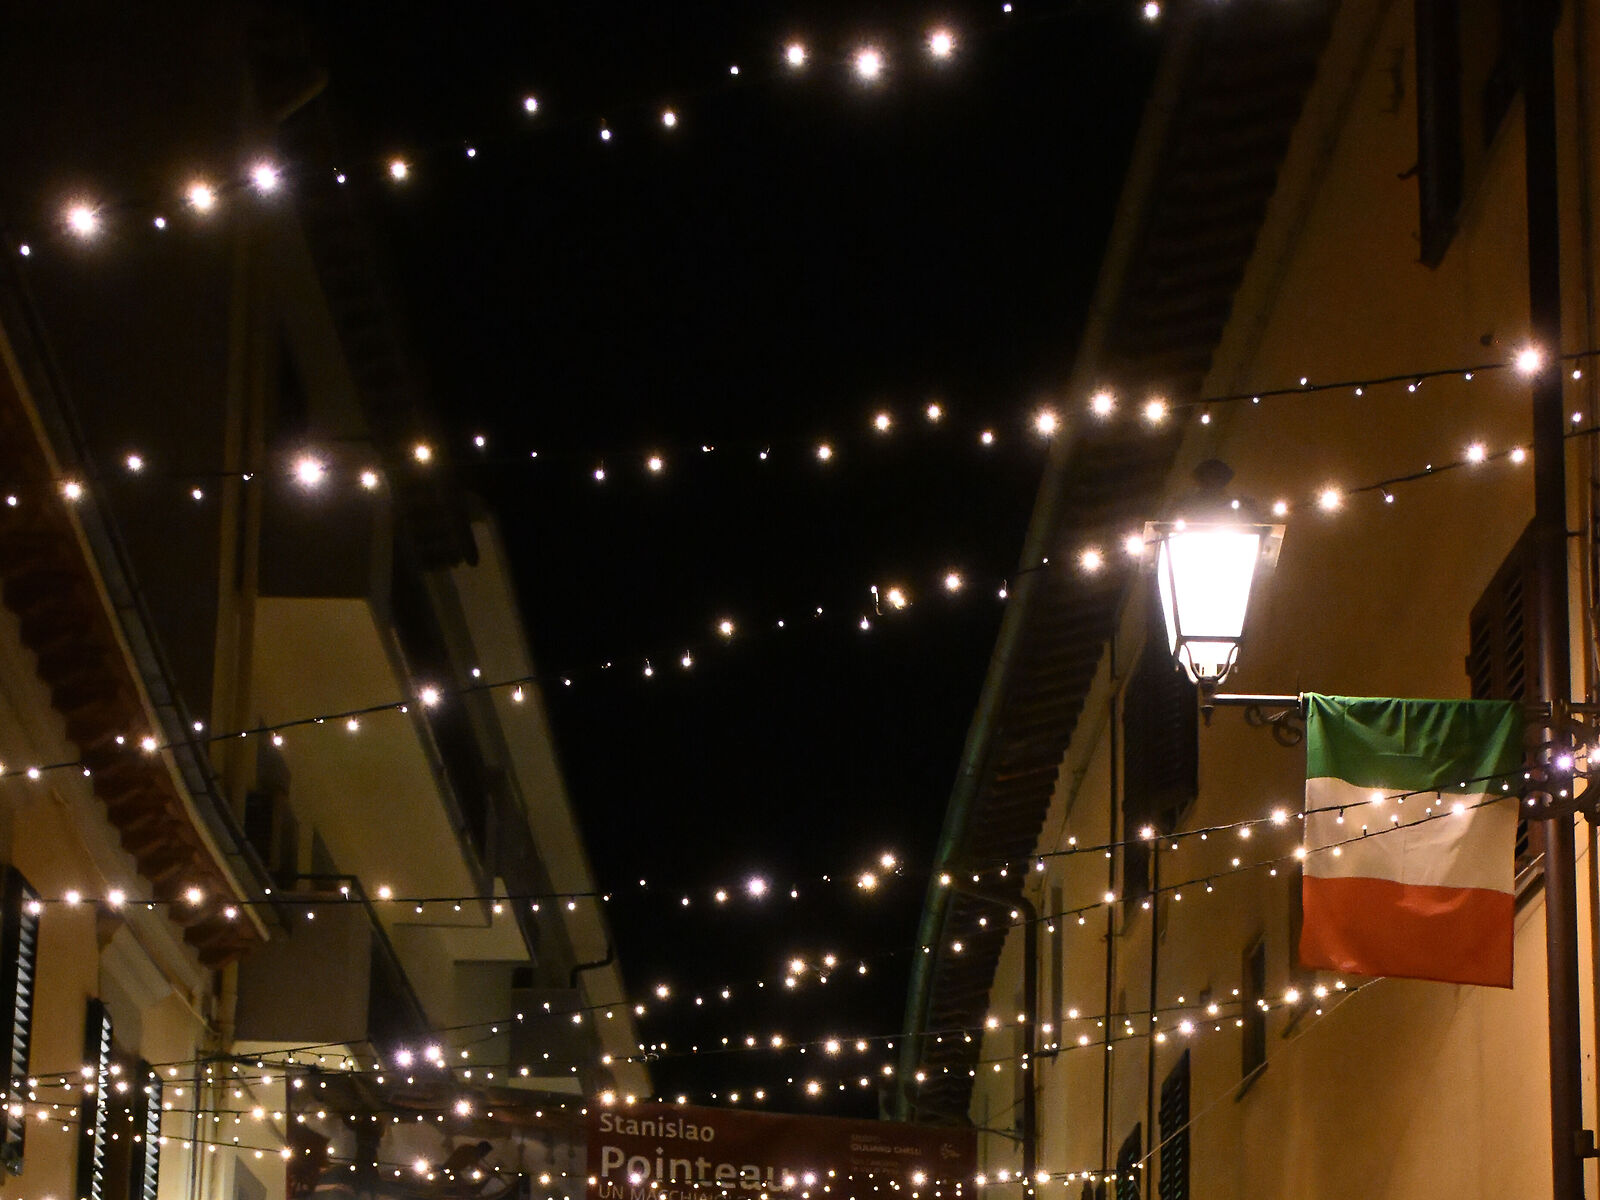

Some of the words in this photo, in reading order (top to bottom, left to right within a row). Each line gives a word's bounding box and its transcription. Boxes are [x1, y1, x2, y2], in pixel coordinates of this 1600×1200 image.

[599, 1112, 715, 1143] Stanislao
[601, 1145, 792, 1193] Pointeau
[599, 1184, 625, 1200] UN
